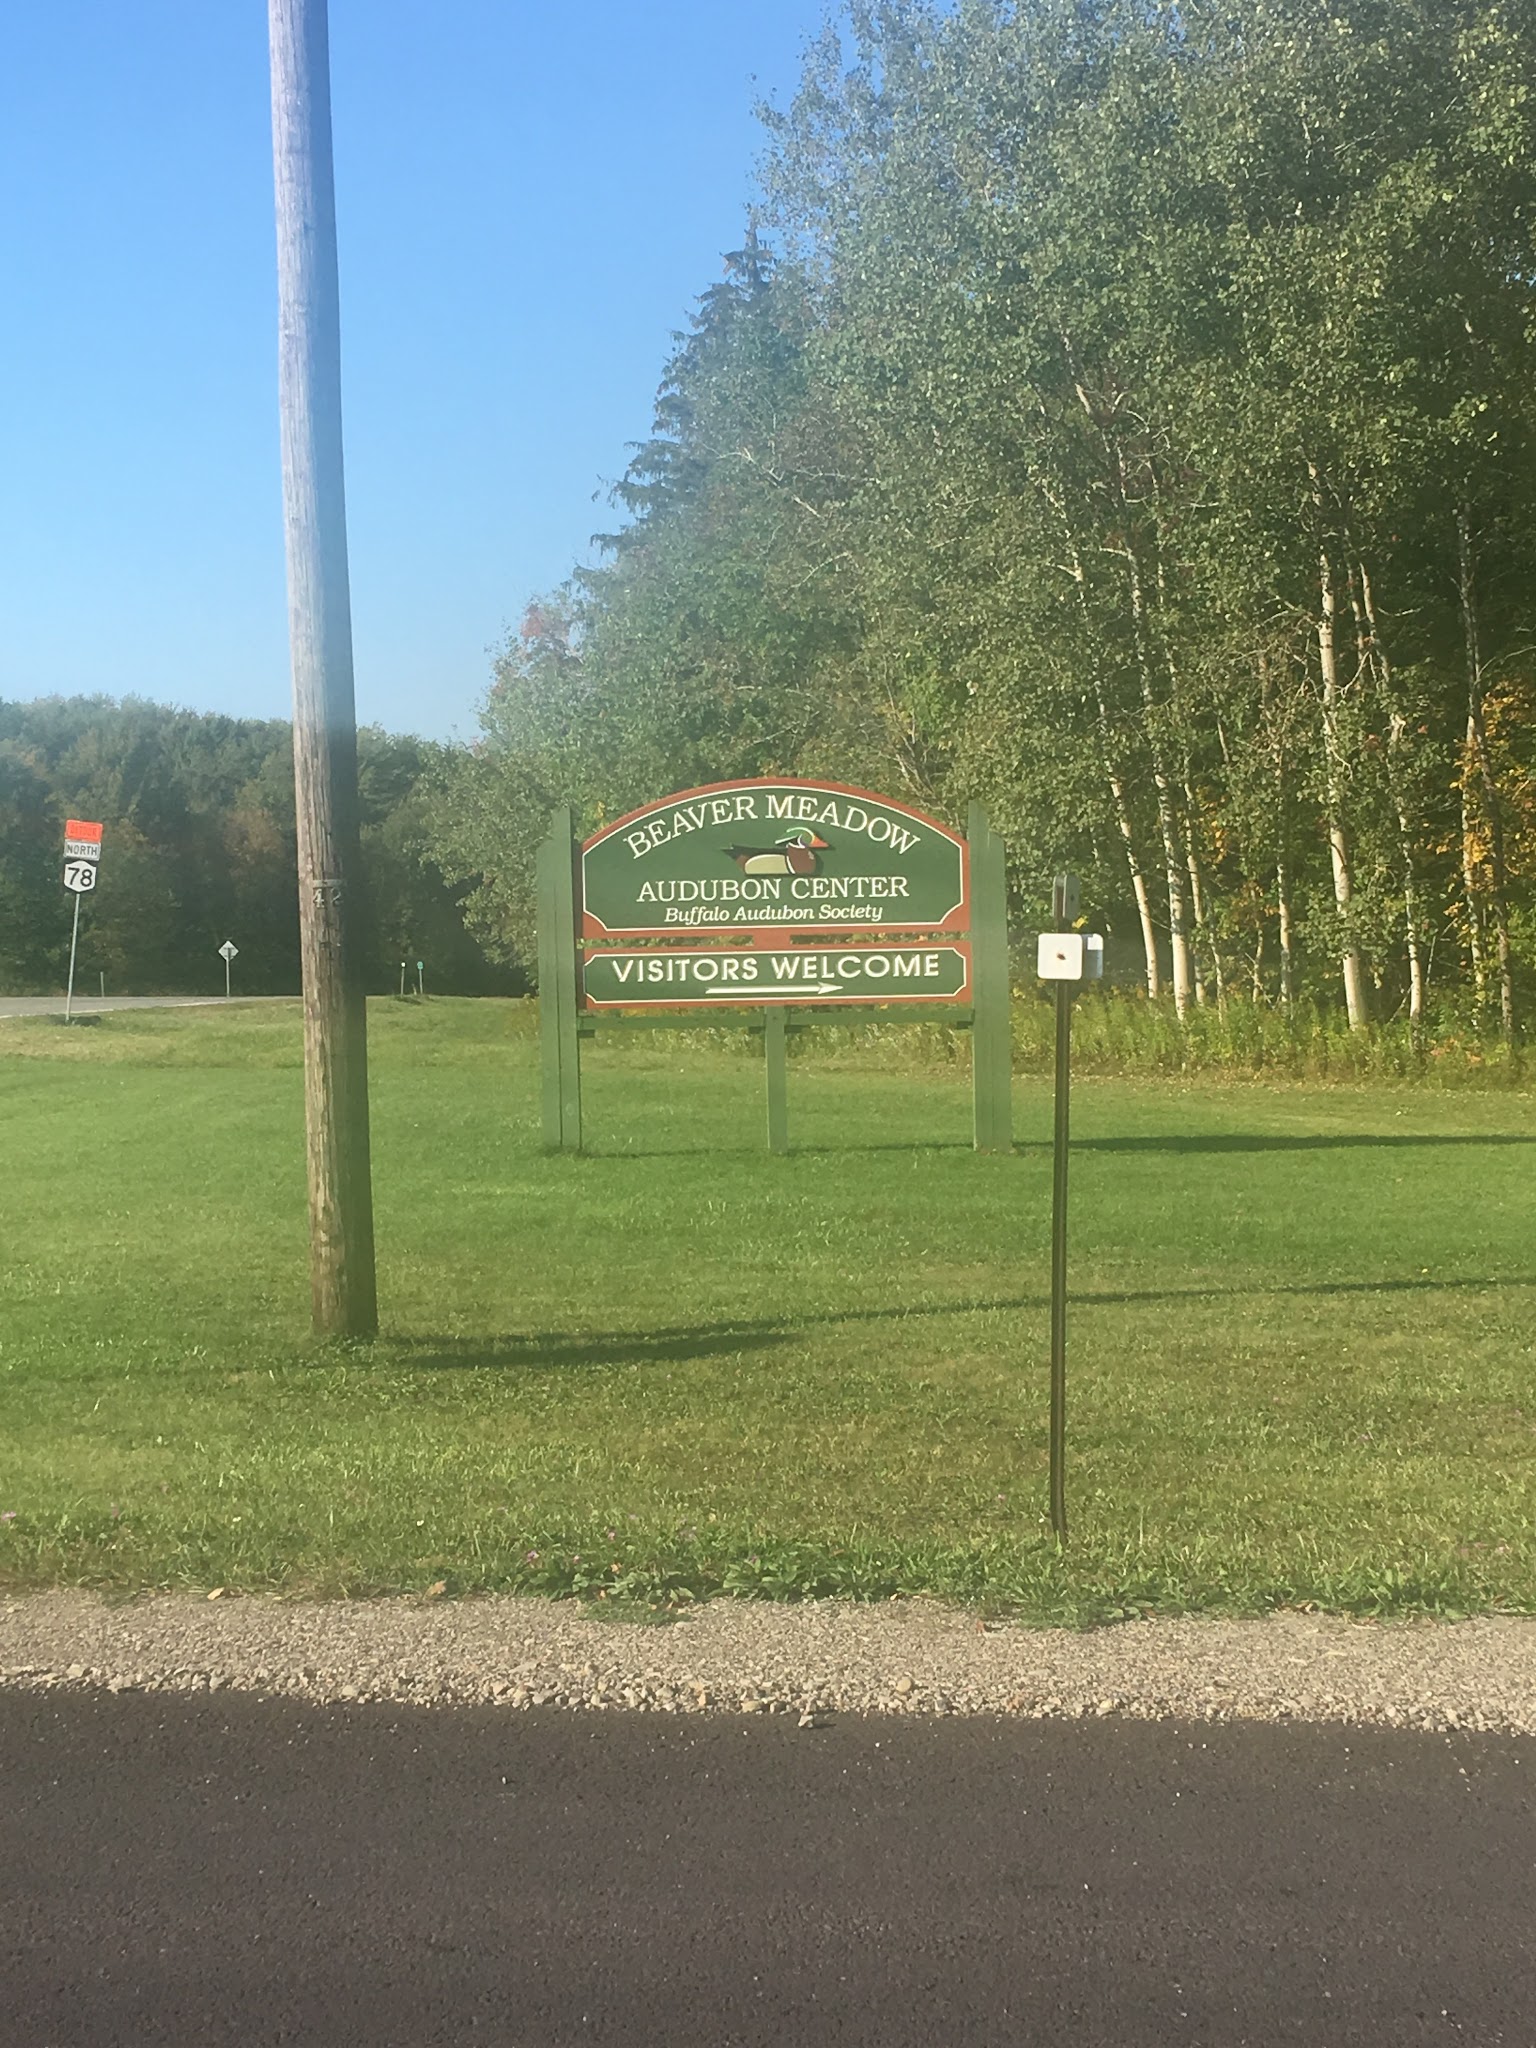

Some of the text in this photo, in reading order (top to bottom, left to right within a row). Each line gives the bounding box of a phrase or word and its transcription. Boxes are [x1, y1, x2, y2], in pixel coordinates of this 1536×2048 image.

[623, 794, 921, 859] BEAVER MEADOW
[67, 845, 97, 855] NORTH
[68, 867, 92, 887] 78
[636, 876, 910, 902] AUDUBON CENTER
[664, 904, 883, 925] Buffalo Audubon Society
[612, 954, 940, 983] VISITORS WELCOME
